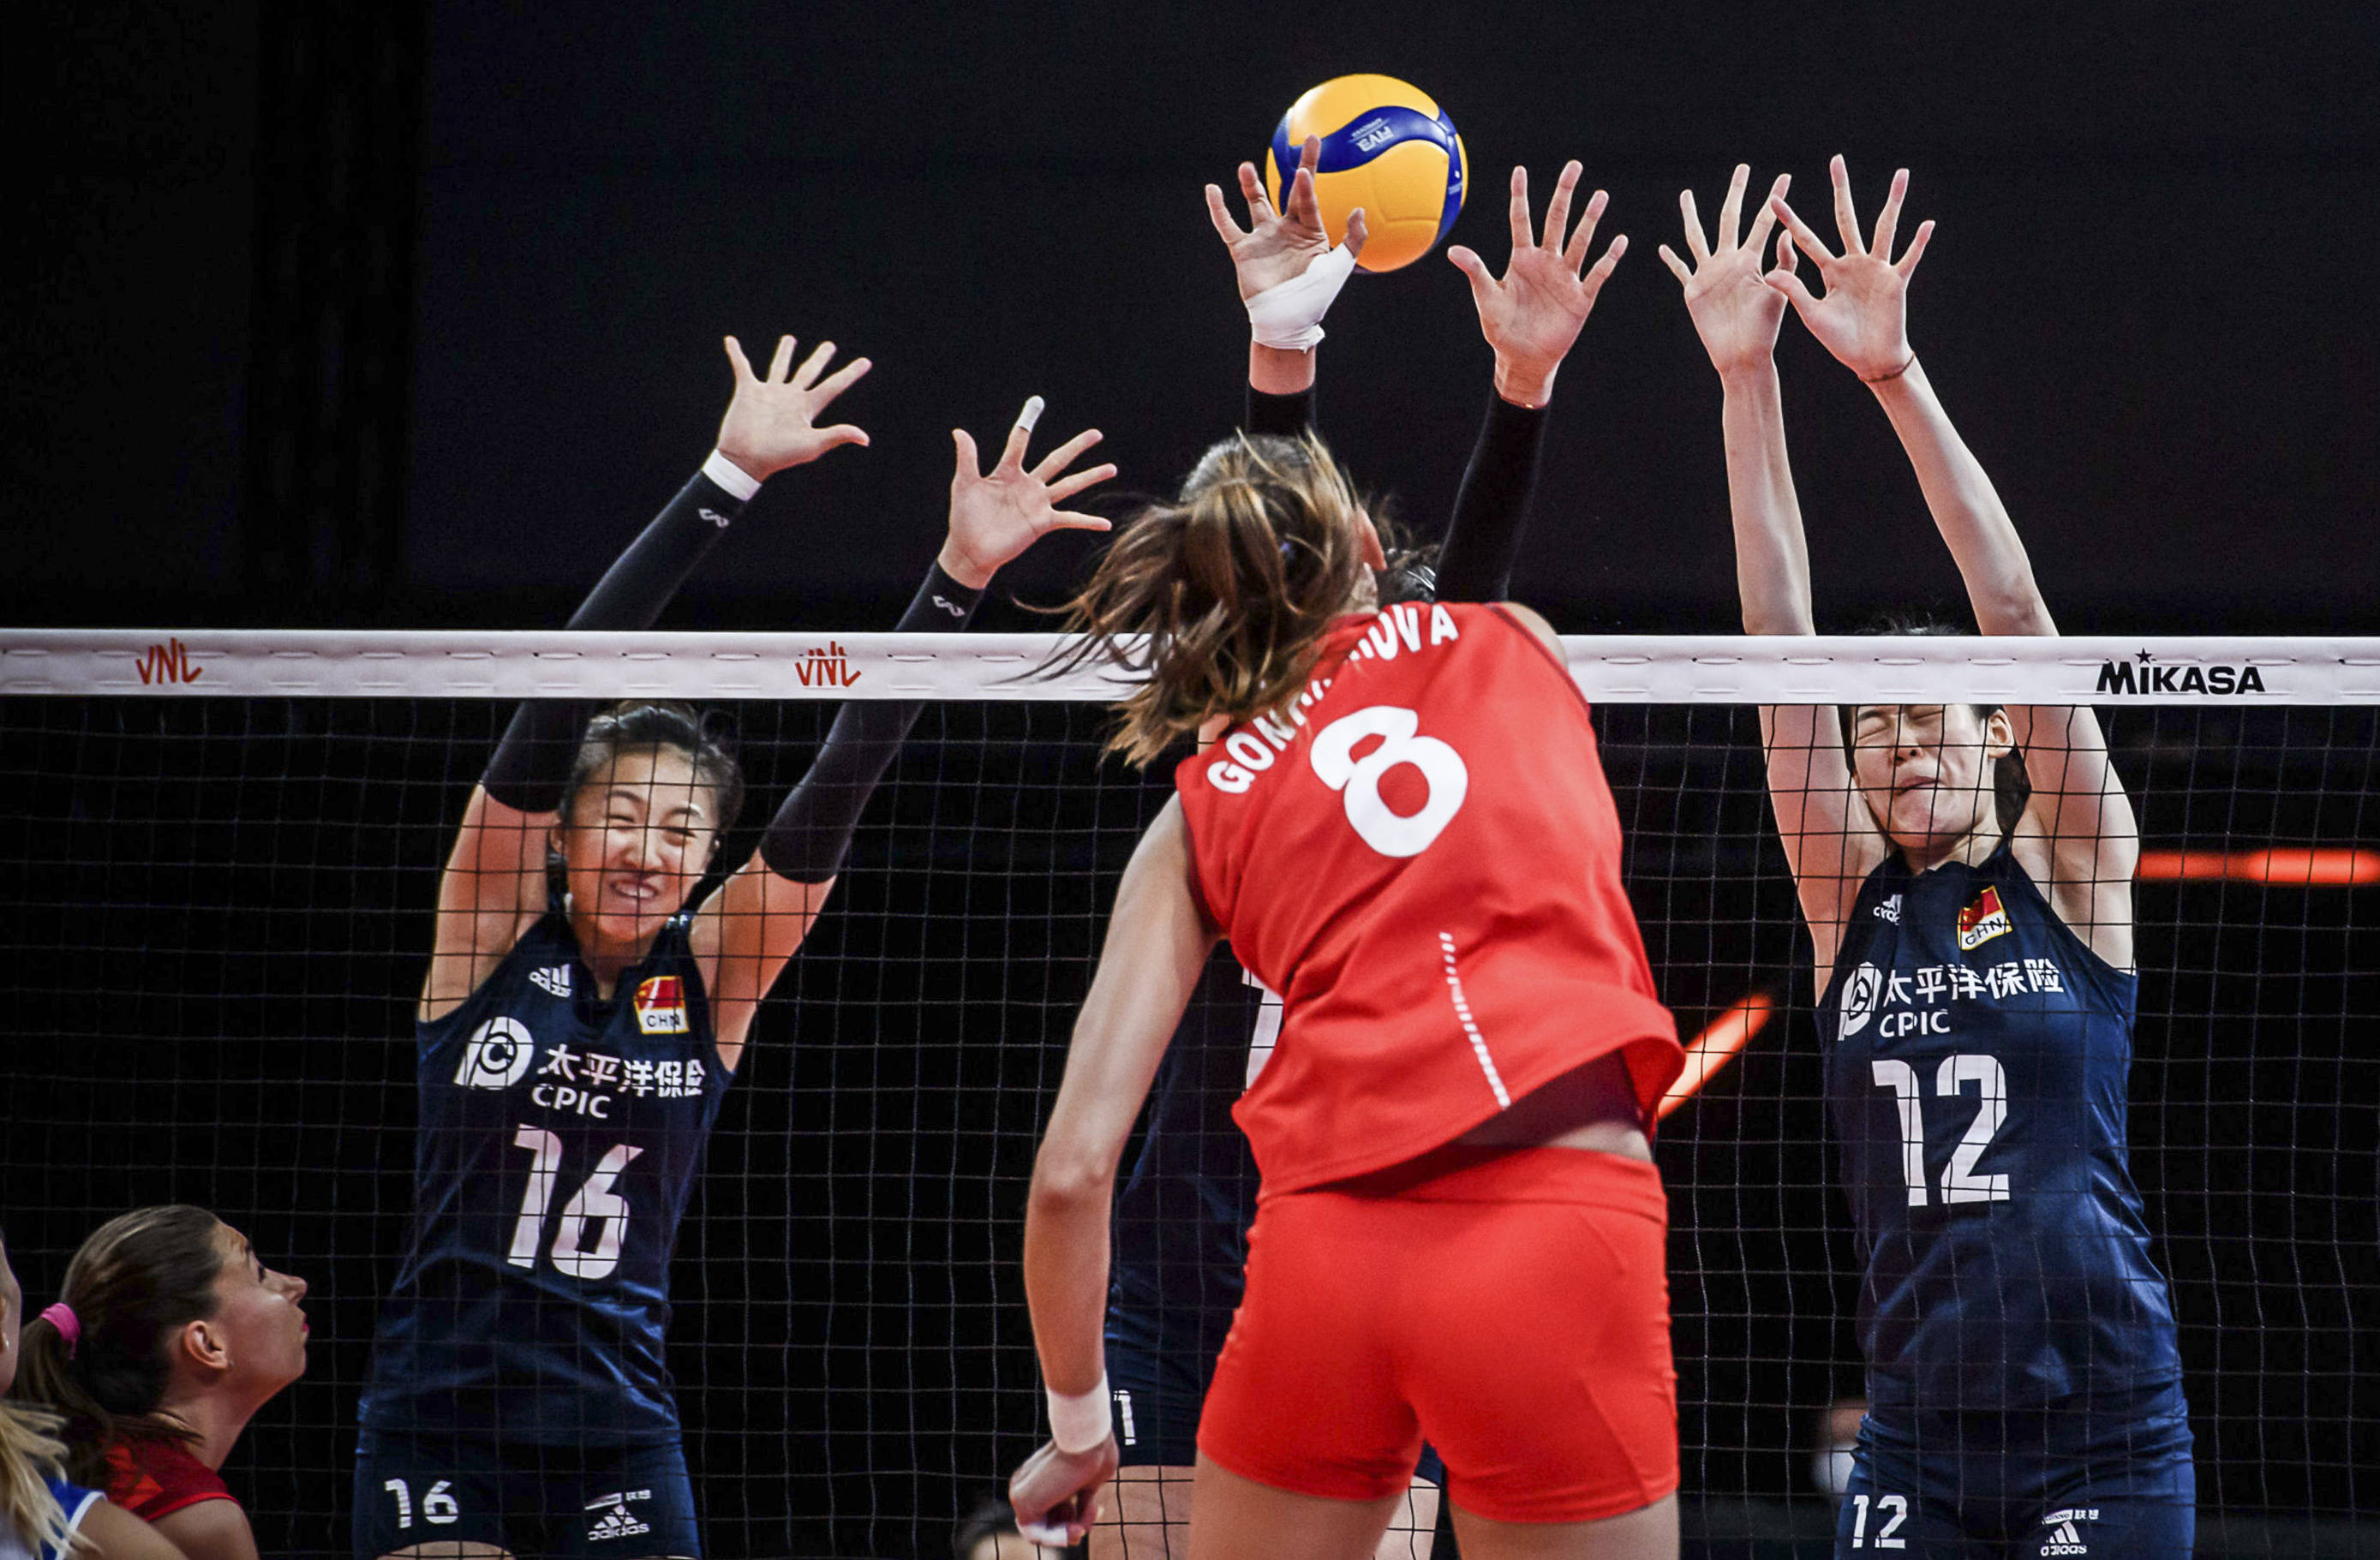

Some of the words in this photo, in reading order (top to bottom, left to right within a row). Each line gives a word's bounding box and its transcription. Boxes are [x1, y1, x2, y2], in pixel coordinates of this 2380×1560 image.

[135, 637, 202, 685] VNL
[795, 641, 861, 687] VNL
[1310, 705, 1468, 858] 8
[1965, 917, 2002, 945] CHN
[1883, 959, 2064, 1007] 太平洋保险
[647, 1013, 680, 1027] CHN
[1880, 1008, 1951, 1038] CPIC
[531, 1083, 612, 1119] CPIC
[1871, 1054, 2011, 1207] 12
[507, 1123, 644, 1280] 16
[384, 1479, 459, 1529] 16
[1852, 1495, 1908, 1549] 12
